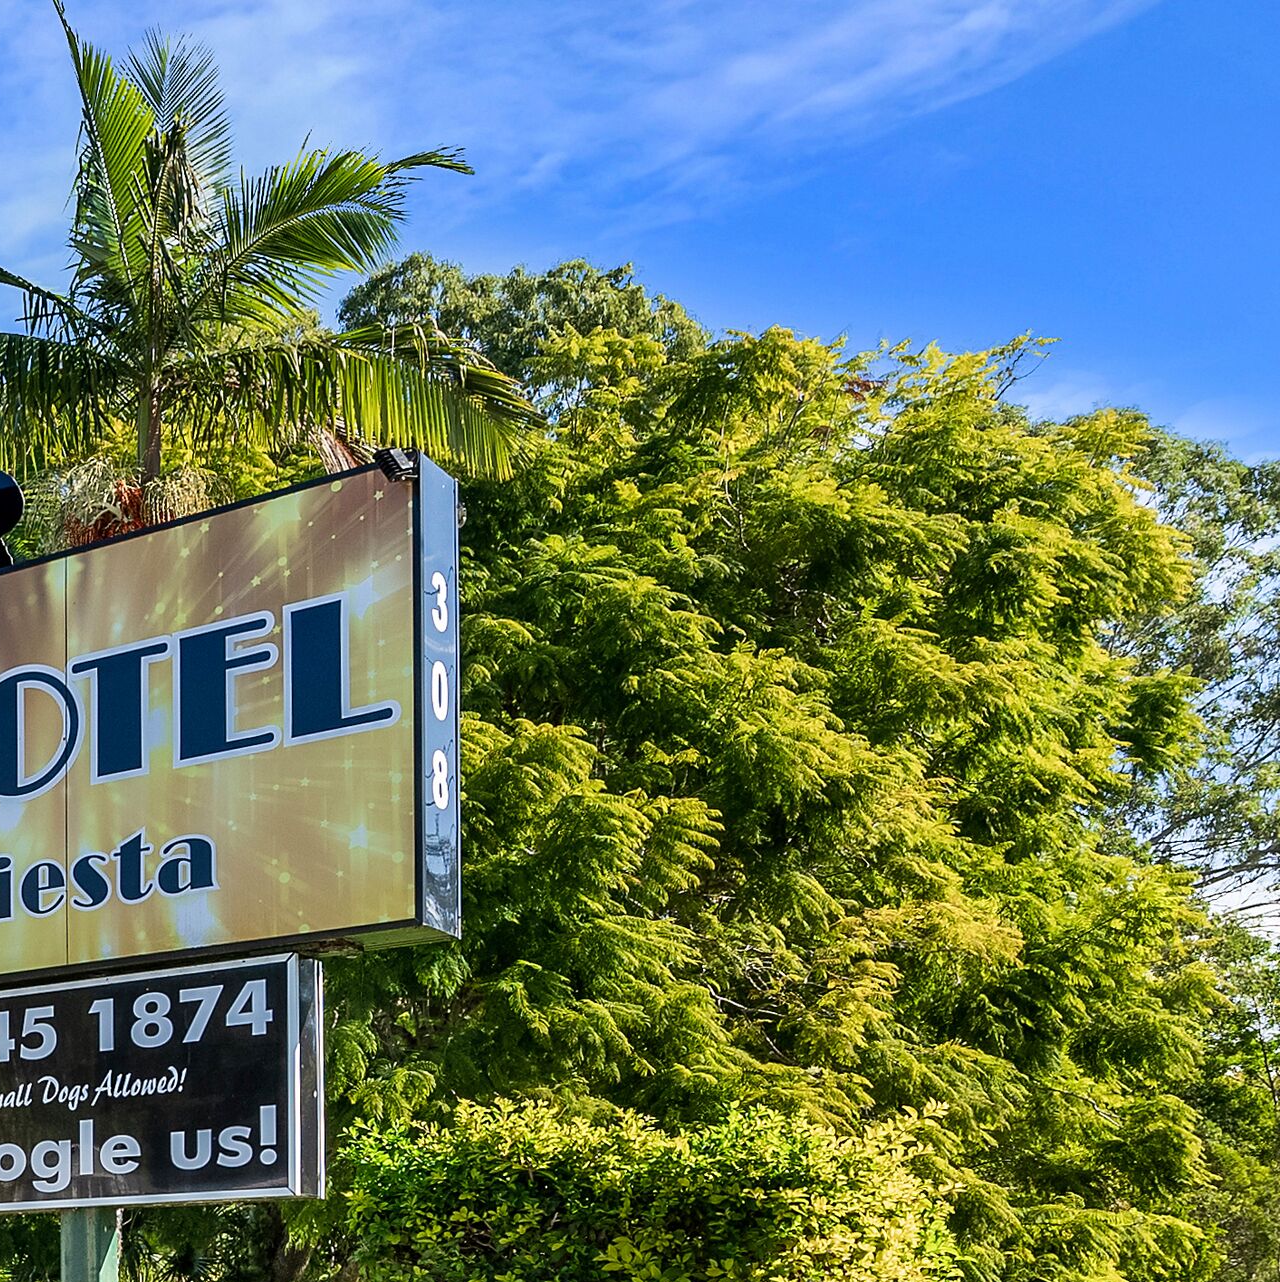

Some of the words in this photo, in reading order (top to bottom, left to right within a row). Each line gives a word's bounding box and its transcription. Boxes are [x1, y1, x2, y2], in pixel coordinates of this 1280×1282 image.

[431, 571, 449, 811] 308
[88, 979, 273, 1052] 1874
[38, 1075, 89, 1111] Dogs
[91, 1066, 188, 1106] Allowed!
[170, 1104, 278, 1170] us!
